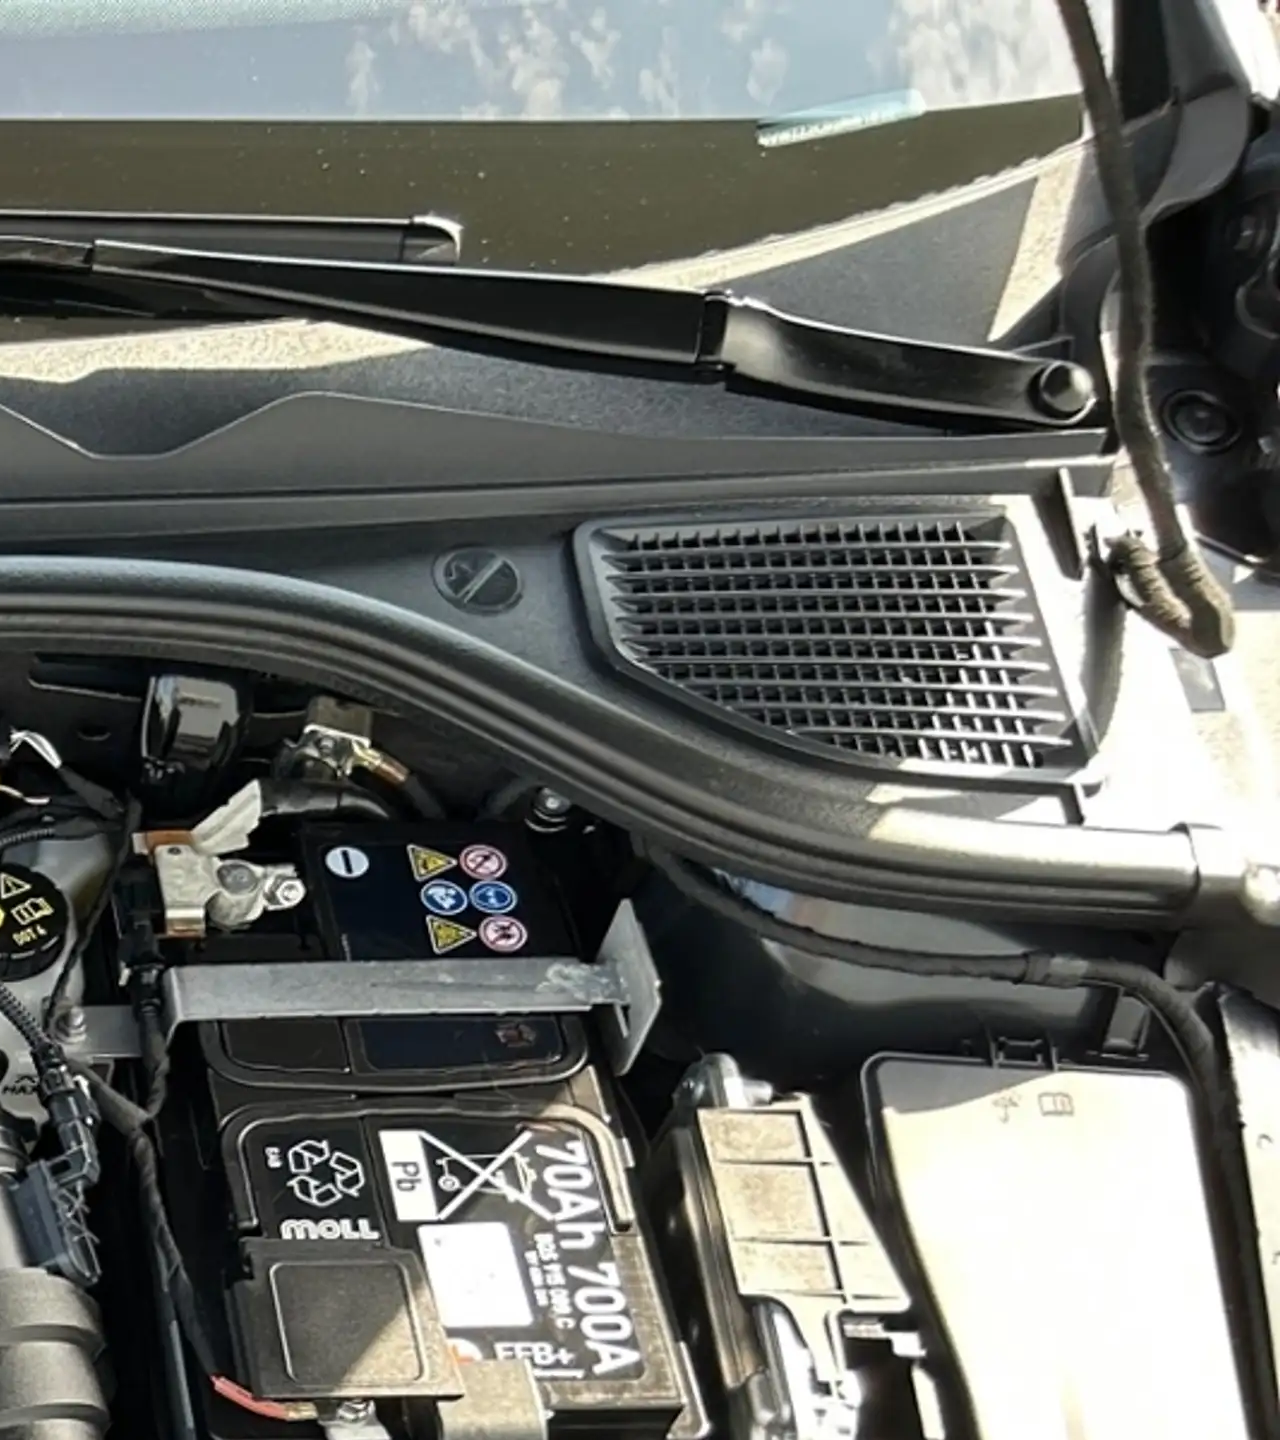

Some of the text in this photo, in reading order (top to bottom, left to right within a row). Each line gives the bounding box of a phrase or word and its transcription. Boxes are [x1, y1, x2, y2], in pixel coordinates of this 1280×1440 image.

[391, 1161, 420, 1192] Pb
[280, 1218, 380, 1240] MOLL
[536, 1140, 641, 1376] 70Ah 700A
